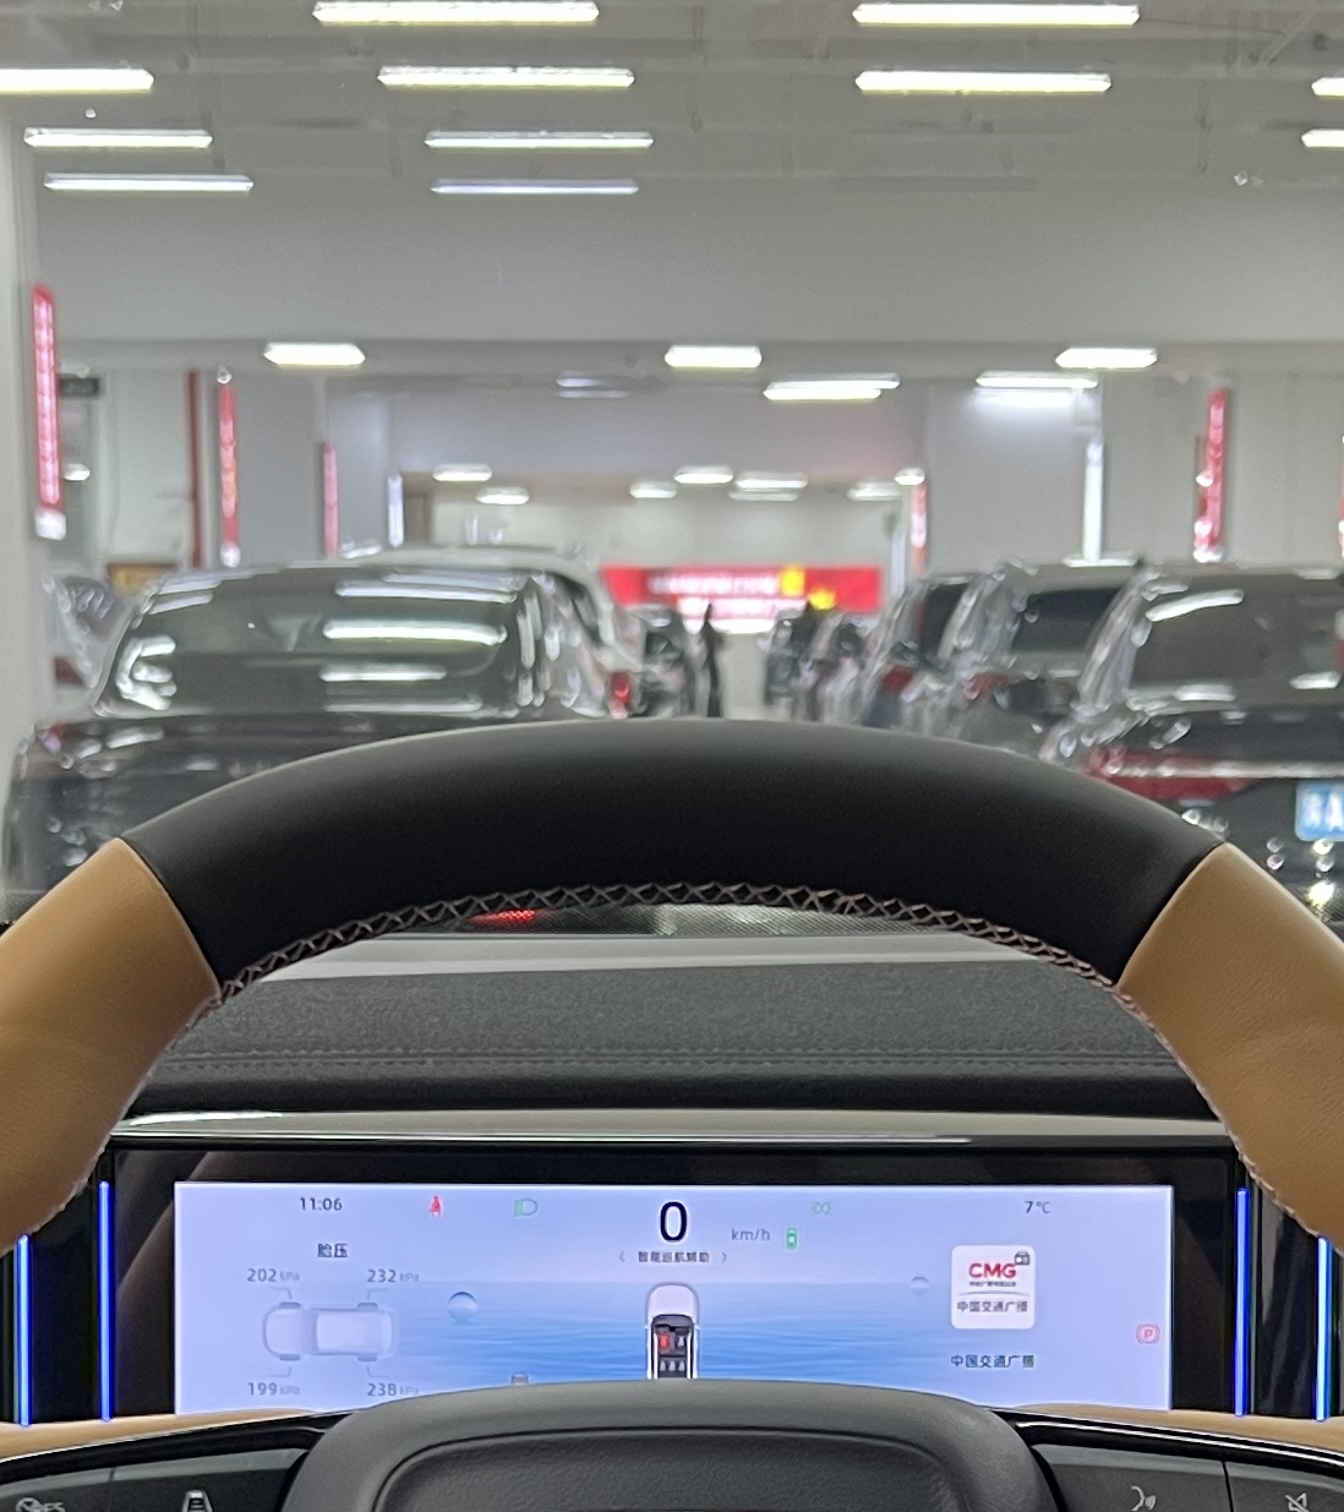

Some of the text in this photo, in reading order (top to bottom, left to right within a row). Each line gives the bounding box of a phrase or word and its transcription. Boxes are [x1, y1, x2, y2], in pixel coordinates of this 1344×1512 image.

[300, 1197, 343, 1211] 11:06
[660, 1201, 687, 1241] 0
[732, 1229, 770, 1241] km/h
[317, 1243, 348, 1258] 胎压
[247, 1268, 277, 1282] 202
[367, 1269, 397, 1283] 232
[969, 1263, 1016, 1278] CMG
[957, 1301, 1027, 1313] 中国交通广播
[951, 1355, 1035, 1368] 中国交通广播
[248, 1382, 277, 1396] 199
[367, 1382, 397, 1396] 238
